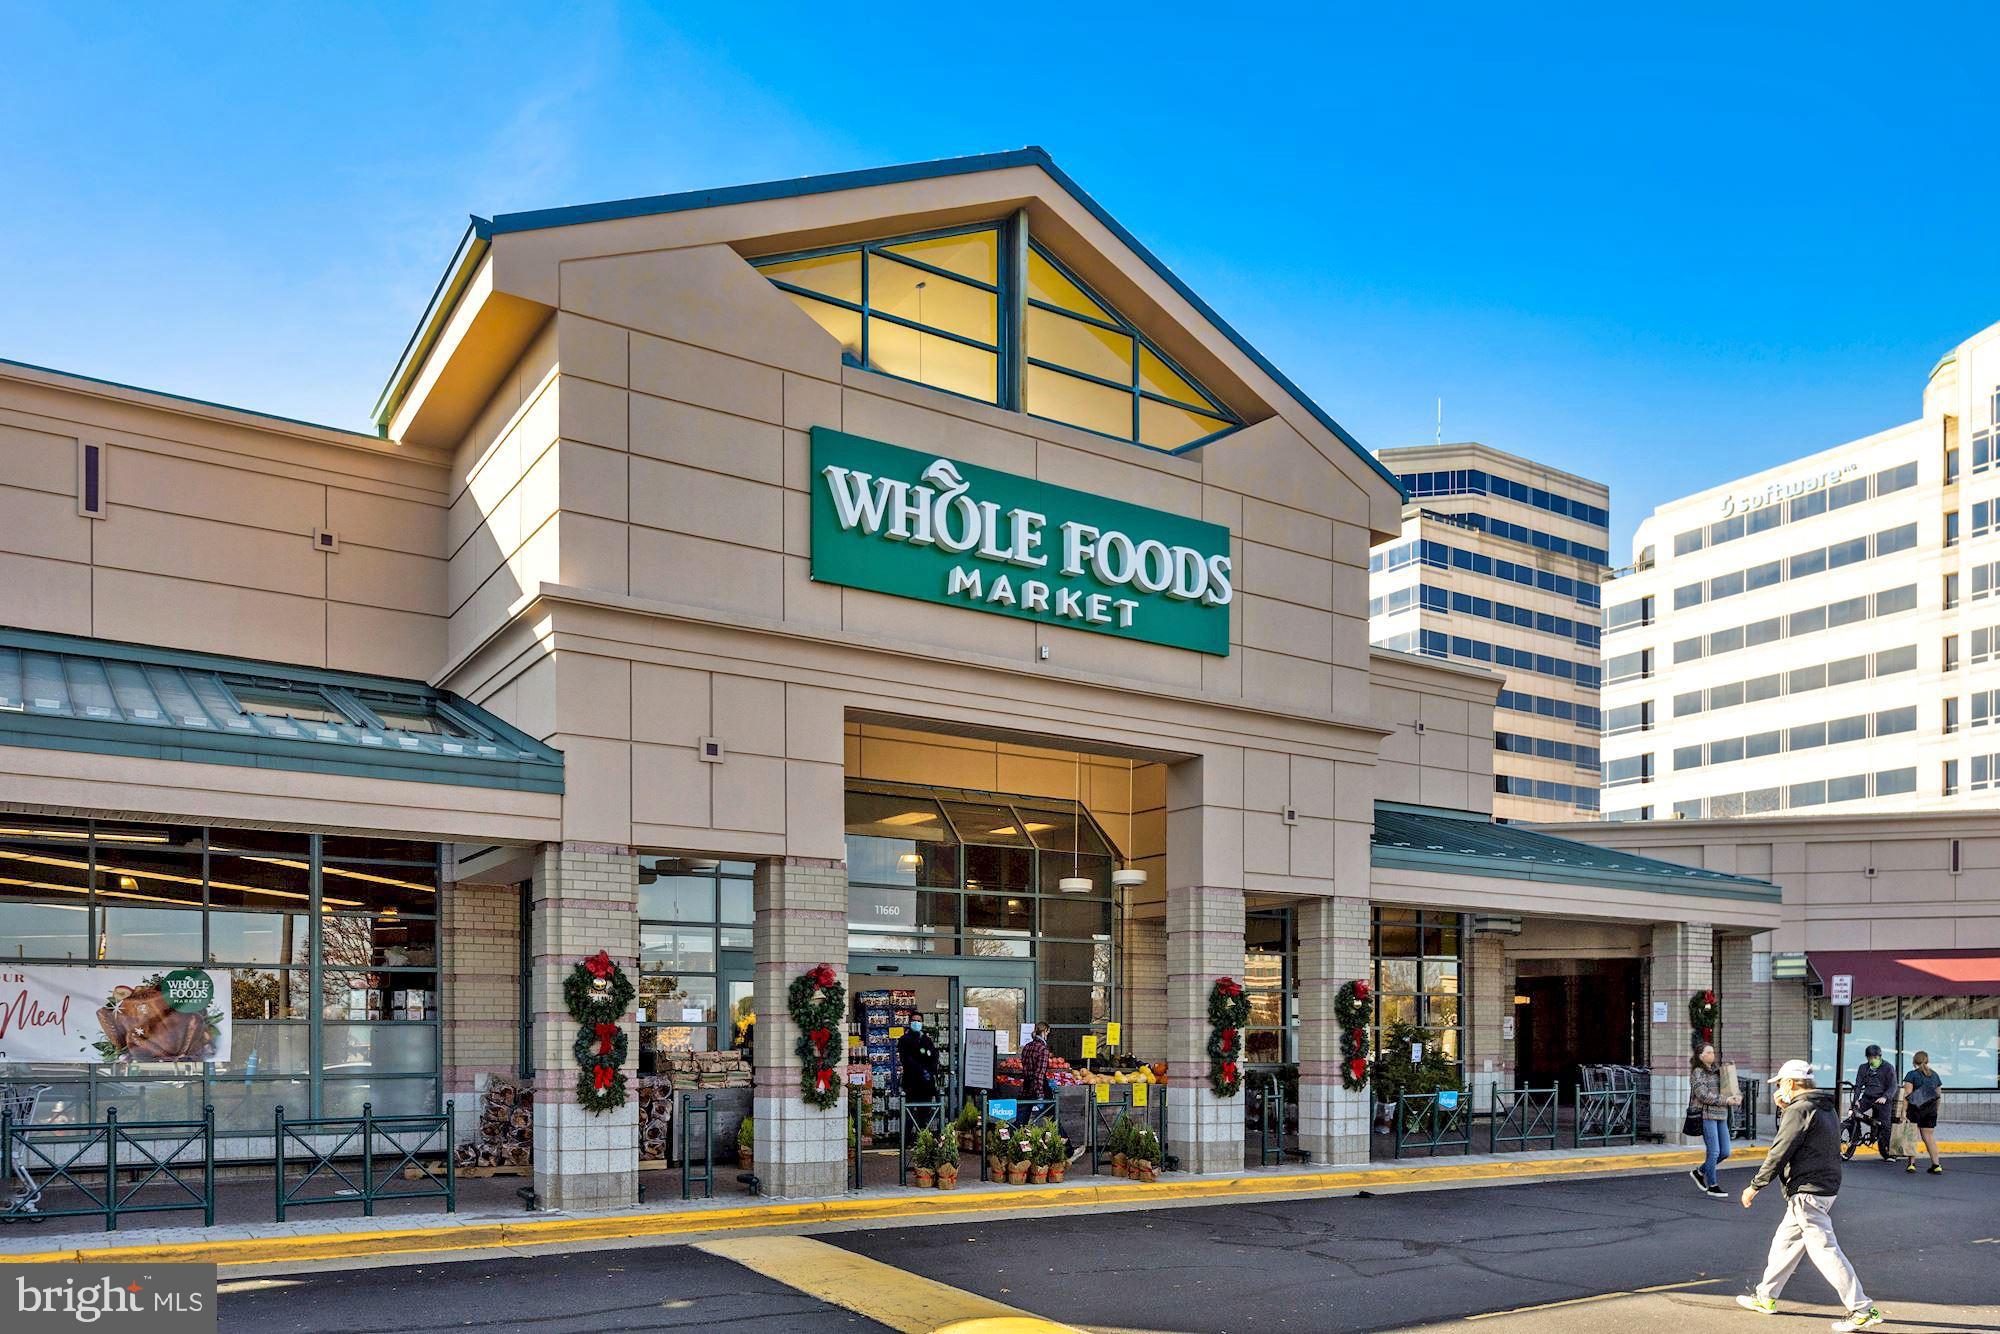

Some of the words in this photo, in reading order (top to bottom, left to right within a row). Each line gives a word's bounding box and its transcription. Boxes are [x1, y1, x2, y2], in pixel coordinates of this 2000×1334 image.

[822, 459, 1048, 569] WHOLE
[1059, 520, 1233, 608] FOODS
[947, 565, 1139, 628] MARKET
[874, 905, 900, 915] 11660
[0, 973, 24, 982] UR
[167, 976, 209, 989] WHOLE
[169, 989, 208, 998] FOODS
[0, 990, 69, 1039] Meal
[992, 1108, 1013, 1116] Pickup
